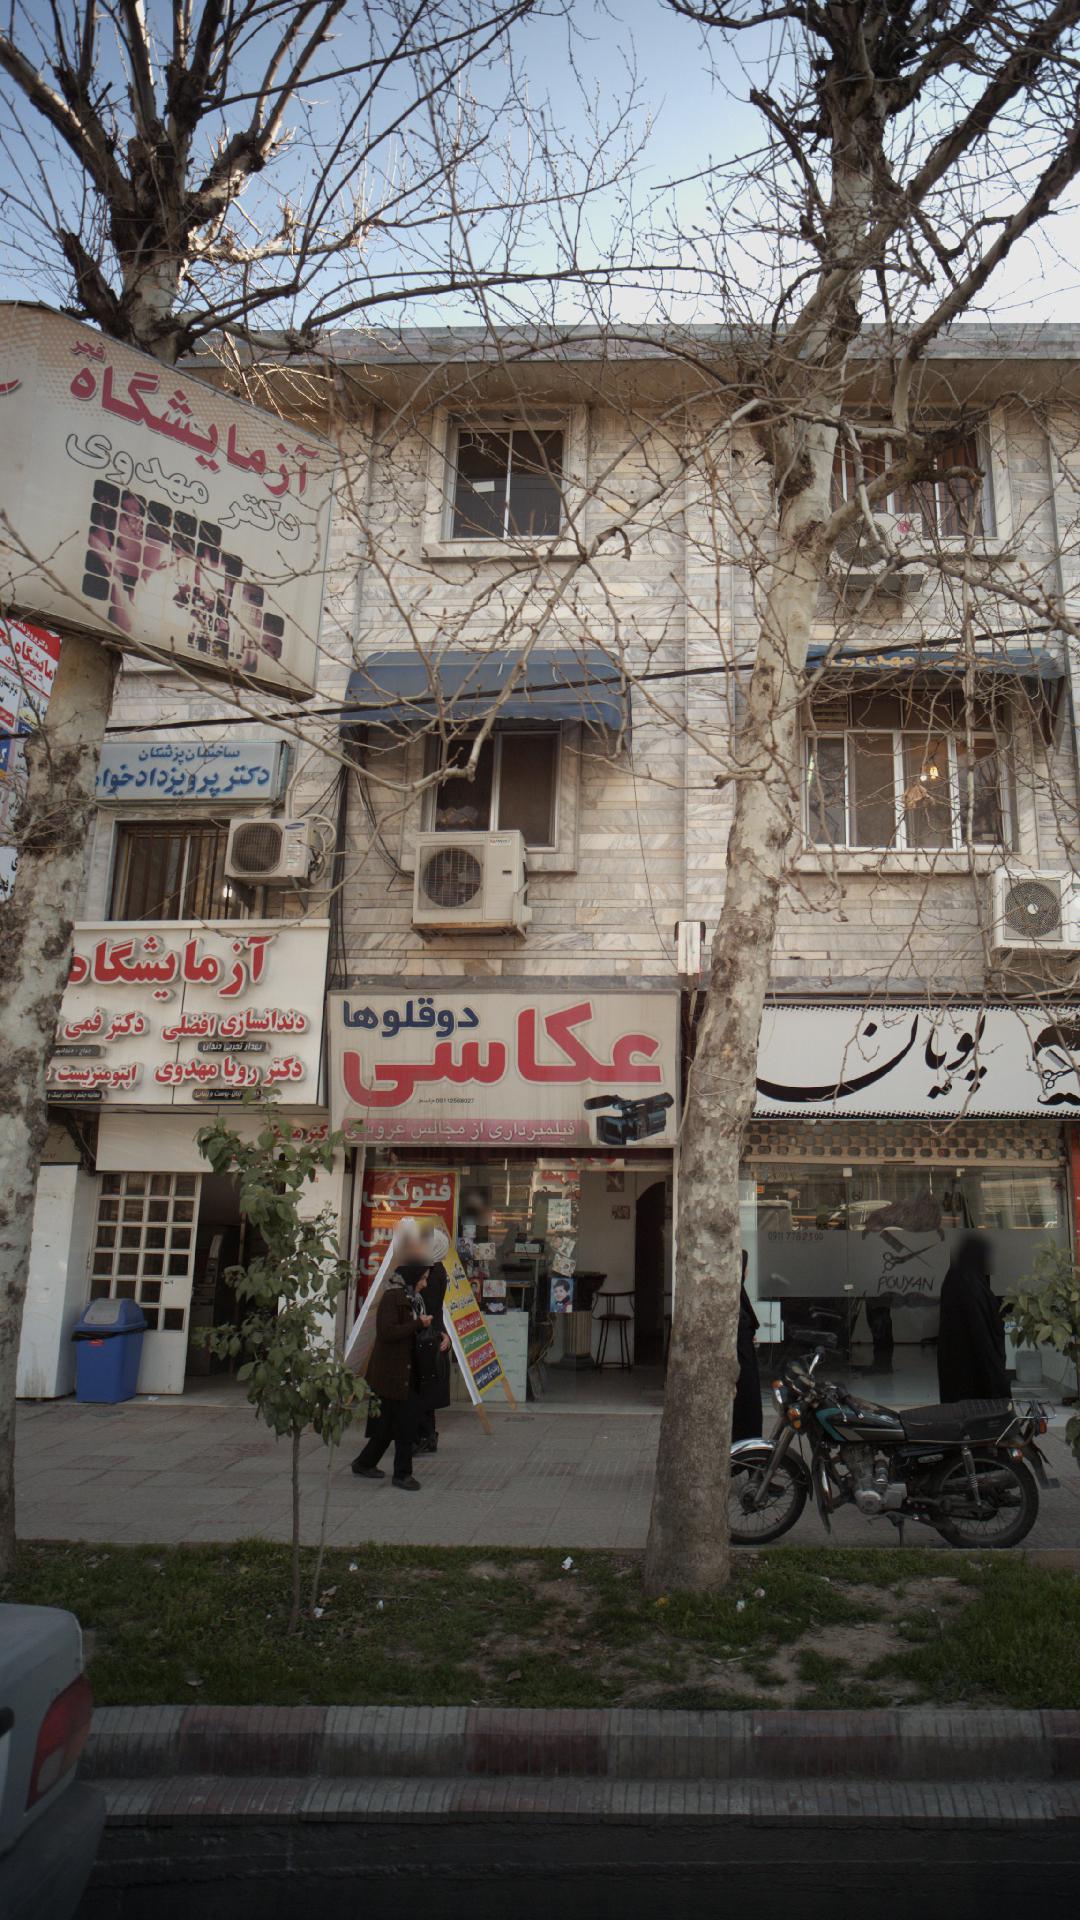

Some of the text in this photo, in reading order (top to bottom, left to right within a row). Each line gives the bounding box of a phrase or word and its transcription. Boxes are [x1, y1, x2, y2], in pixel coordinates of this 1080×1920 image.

[69, 365, 321, 497] آزمایشگاه
[65, 433, 301, 542] دکتر مهدوی
[138, 744, 185, 765] پزشکان
[223, 765, 271, 792] دکتر
[68, 934, 276, 1001] آزمایشگاه
[104, 1011, 146, 1041] دکتر
[161, 1012, 216, 1041] افضلی
[219, 1008, 308, 1038] دندانسازی
[342, 997, 480, 1037] دوقلوها
[343, 1001, 663, 1107] عکاسی
[57, 1063, 138, 1090] اپتومتریست
[154, 1058, 218, 1085] مهدوی
[222, 1055, 260, 1086] رویا
[263, 1056, 305, 1086] دکتر
[410, 1121, 466, 1142] مجالس
[469, 1121, 484, 1140] از
[488, 1121, 577, 1143] فیلمبرداری
[877, 1276, 936, 1291] POUYAN
